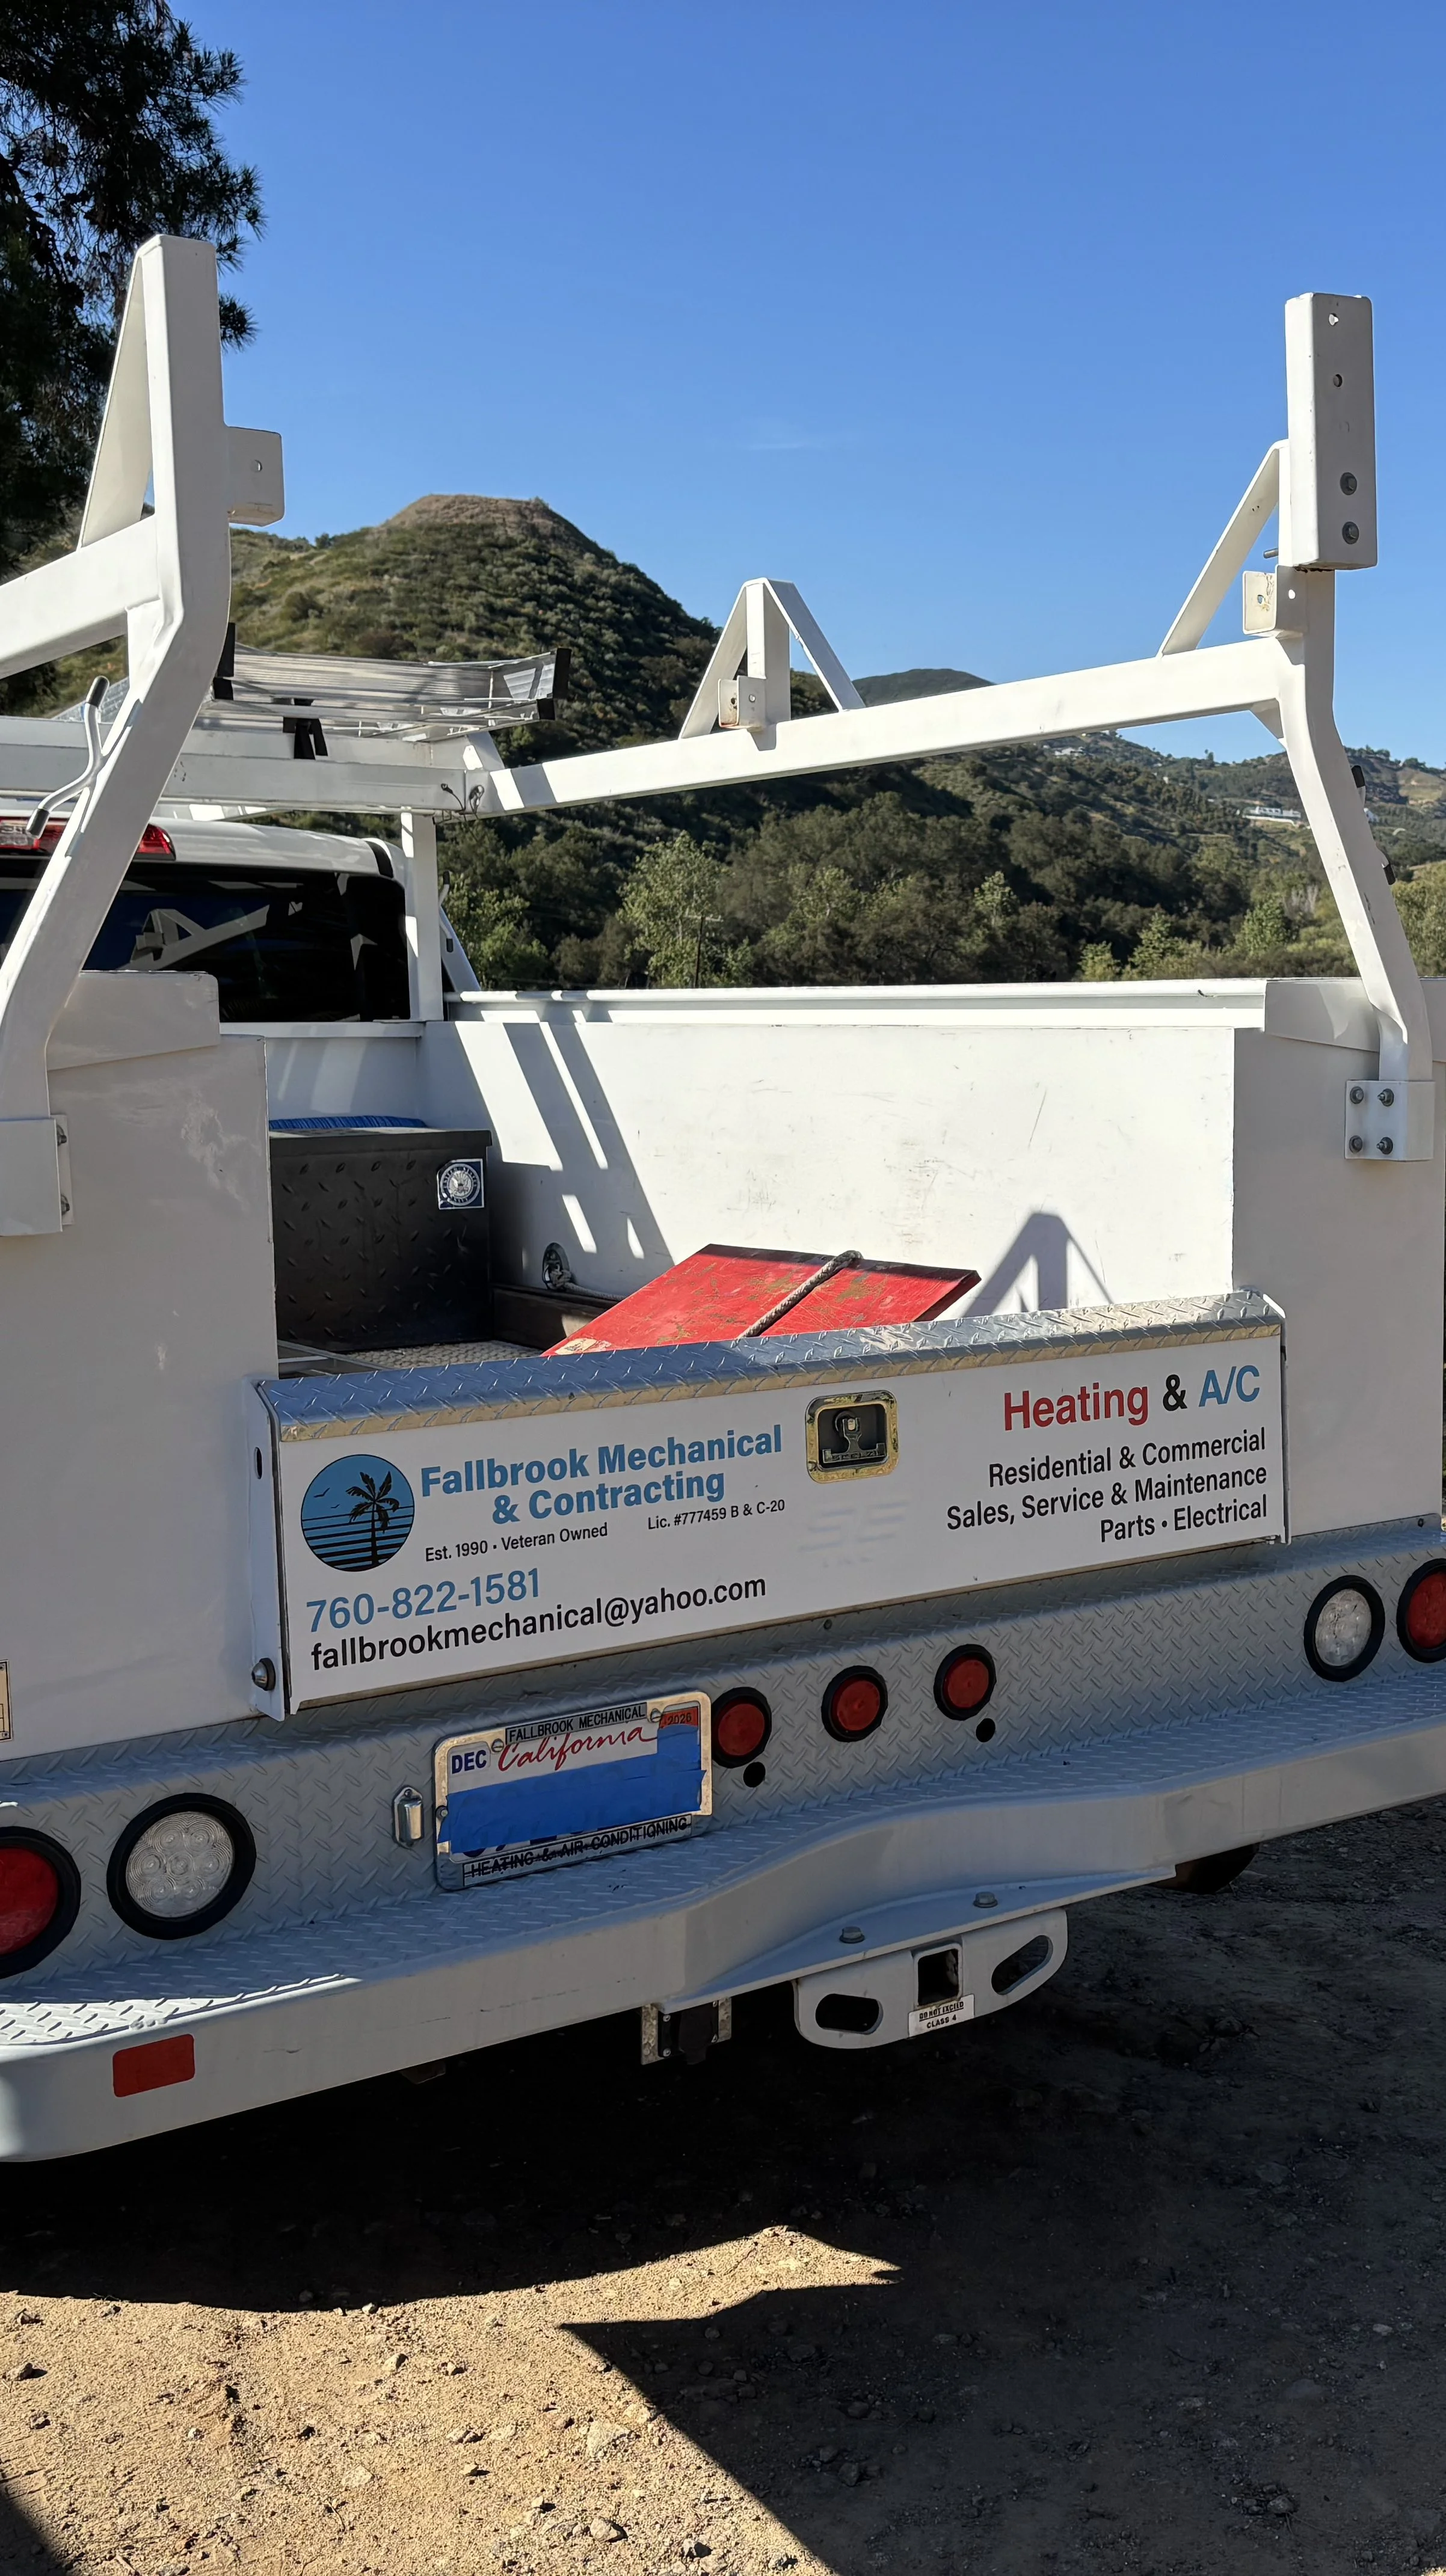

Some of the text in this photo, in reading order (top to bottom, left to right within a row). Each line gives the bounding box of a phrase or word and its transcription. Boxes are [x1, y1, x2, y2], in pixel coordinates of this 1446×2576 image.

[1004, 1364, 1260, 1431] Heating & A/C
[421, 1424, 782, 1497] Fallbrook Mechanical
[989, 1427, 1266, 1488] Residential & Commercial
[492, 1470, 725, 1524] & Contracting
[648, 1499, 785, 1529] Lic. #777459 B & C-20
[947, 1465, 1267, 1530] Sales, Service & Maintenance
[1100, 1494, 1267, 1543] Parts Electrical
[425, 1522, 608, 1562] Est. 1990 Veteran Owned
[307, 1568, 540, 1633] 760-822-1581
[311, 1576, 766, 1671] fallbrookmechanical@yahoo.com
[509, 1706, 645, 1742] FALLBROOK MECHANICAL
[668, 1713, 691, 1725] 2026
[452, 1749, 487, 1774] DEC
[498, 1726, 657, 1771] California
[472, 1851, 534, 1877] HEATING
[561, 1841, 583, 1857] AIR
[591, 1818, 687, 1850] CONDITIONING
[927, 2016, 949, 2028] CLASS
